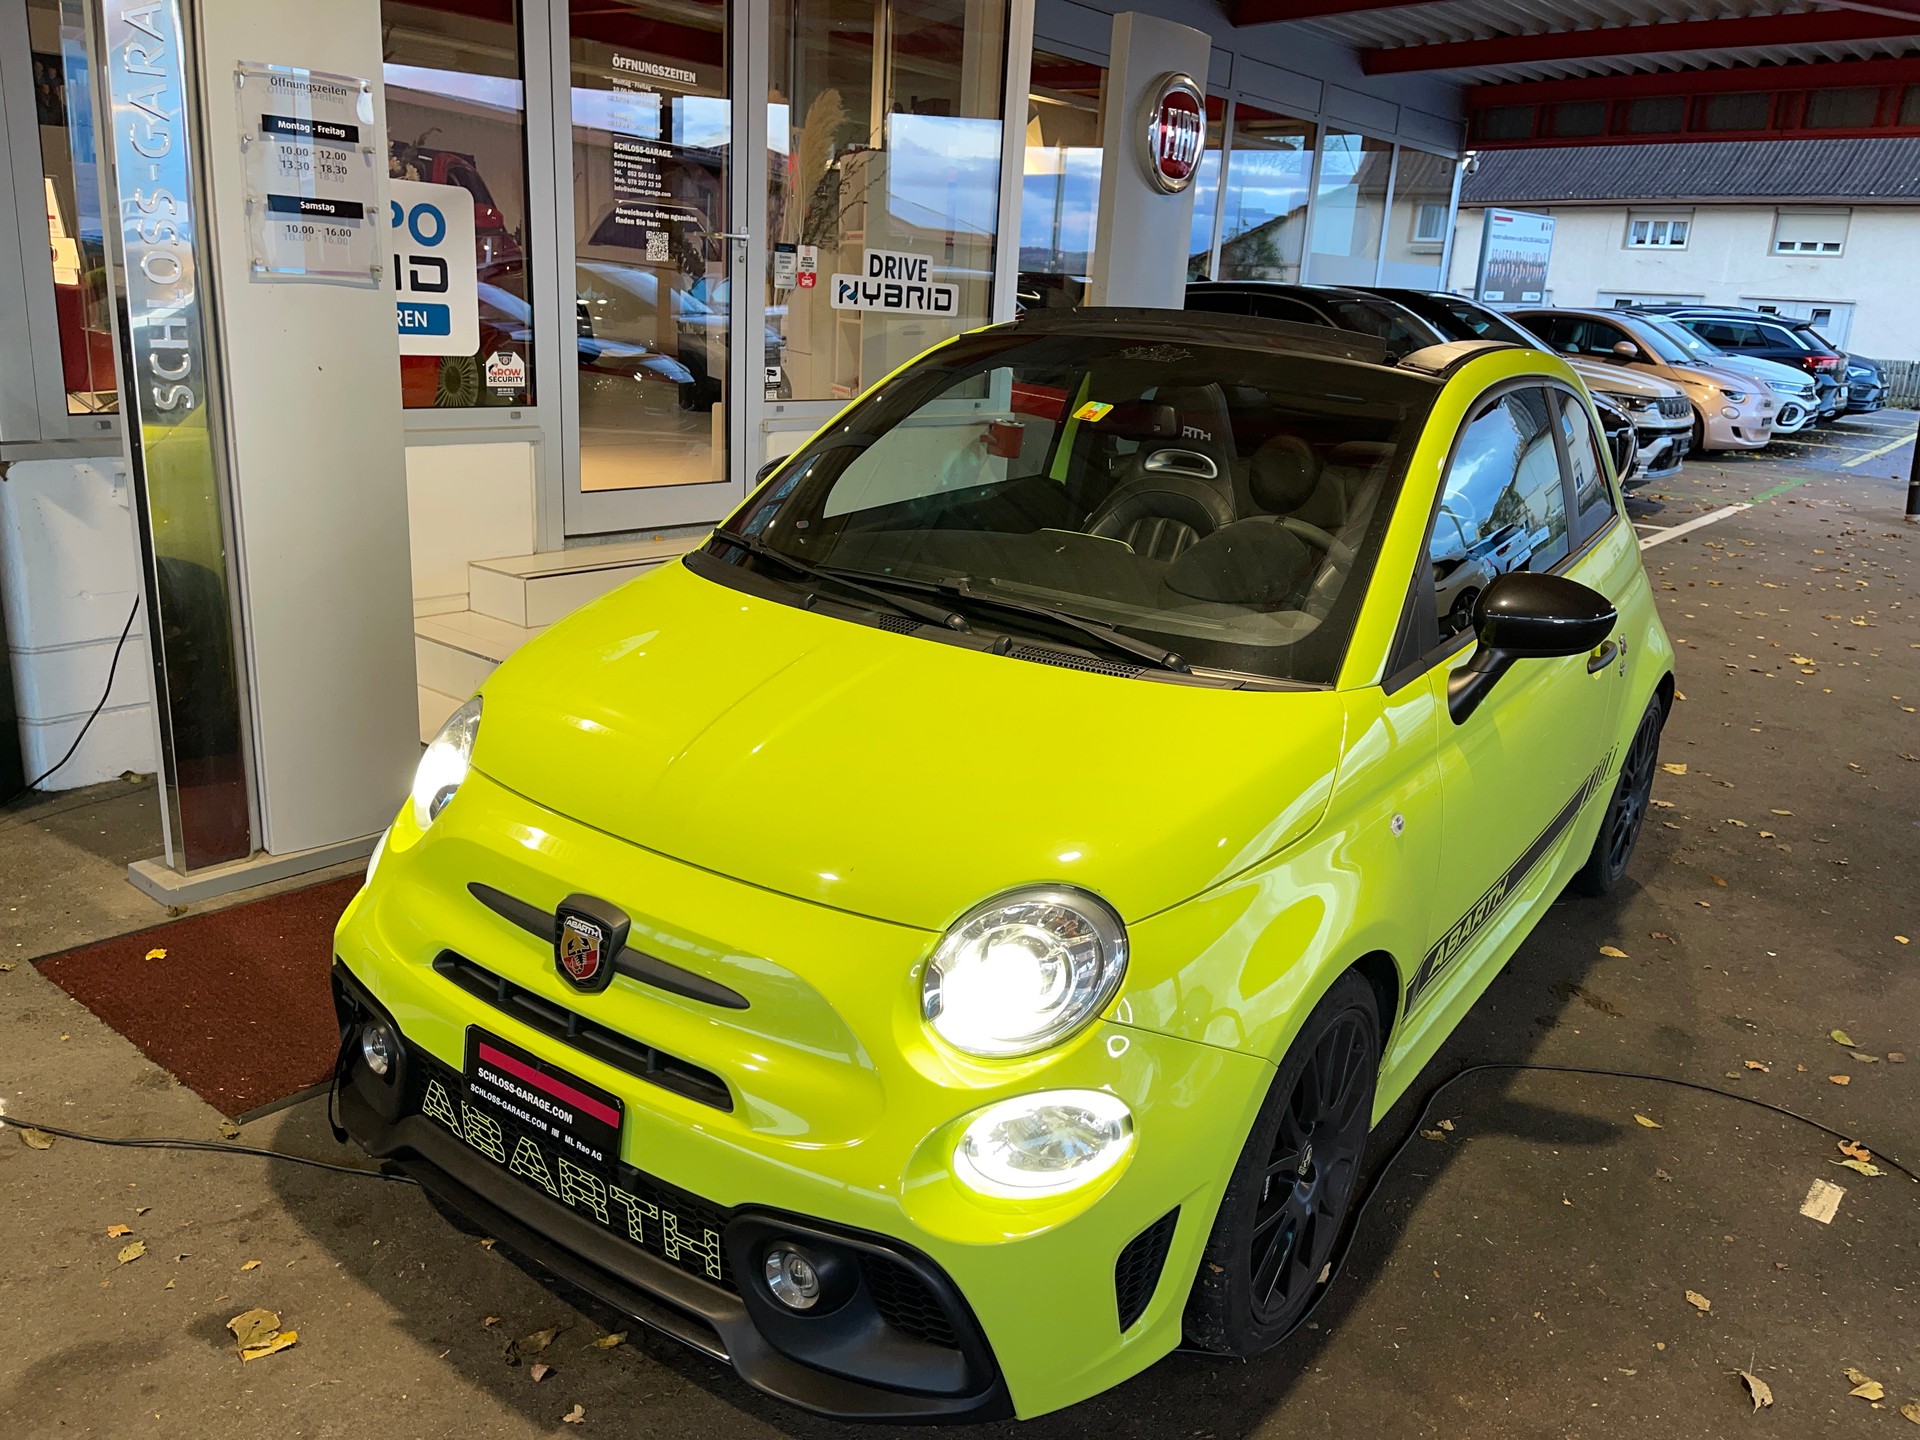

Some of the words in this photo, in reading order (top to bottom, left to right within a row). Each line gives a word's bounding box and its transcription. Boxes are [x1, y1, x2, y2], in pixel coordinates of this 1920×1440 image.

[612, 53, 696, 83] ÖFFNUNGSZEITEN
[270, 75, 348, 97] Öffnungszeiten
[278, 120, 310, 133] Montag
[317, 125, 346, 138] Freitag
[1164, 107, 1199, 164] FIAT
[281, 146, 309, 156] 10.00
[319, 150, 347, 161] 12.00
[613, 142, 673, 158] SCHLOSS-GARAGE.
[281, 160, 310, 171] 13.30
[321, 164, 348, 175] 18.30
[300, 200, 335, 213] Samstag
[615, 207, 654, 218] Abweichende
[615, 216, 635, 225] finden
[636, 218, 646, 226] Sie
[286, 224, 314, 235] 10.00
[326, 227, 352, 238] 16.00
[869, 253, 928, 283] DRIVE
[838, 279, 952, 312] HYBRID
[488, 375, 523, 383] SECURITY
[566, 919, 599, 937] ABARTH
[1428, 874, 1510, 977] ABARTH
[478, 1067, 573, 1124] SCHLOSS-GARAGE.COM
[470, 1083, 548, 1132] SCHLOSS-GARAGE.COM
[564, 1134, 575, 1147] ML
[576, 1141, 590, 1155] Rao
[591, 1149, 603, 1161] AG
[422, 1079, 722, 1280] ABARTH
